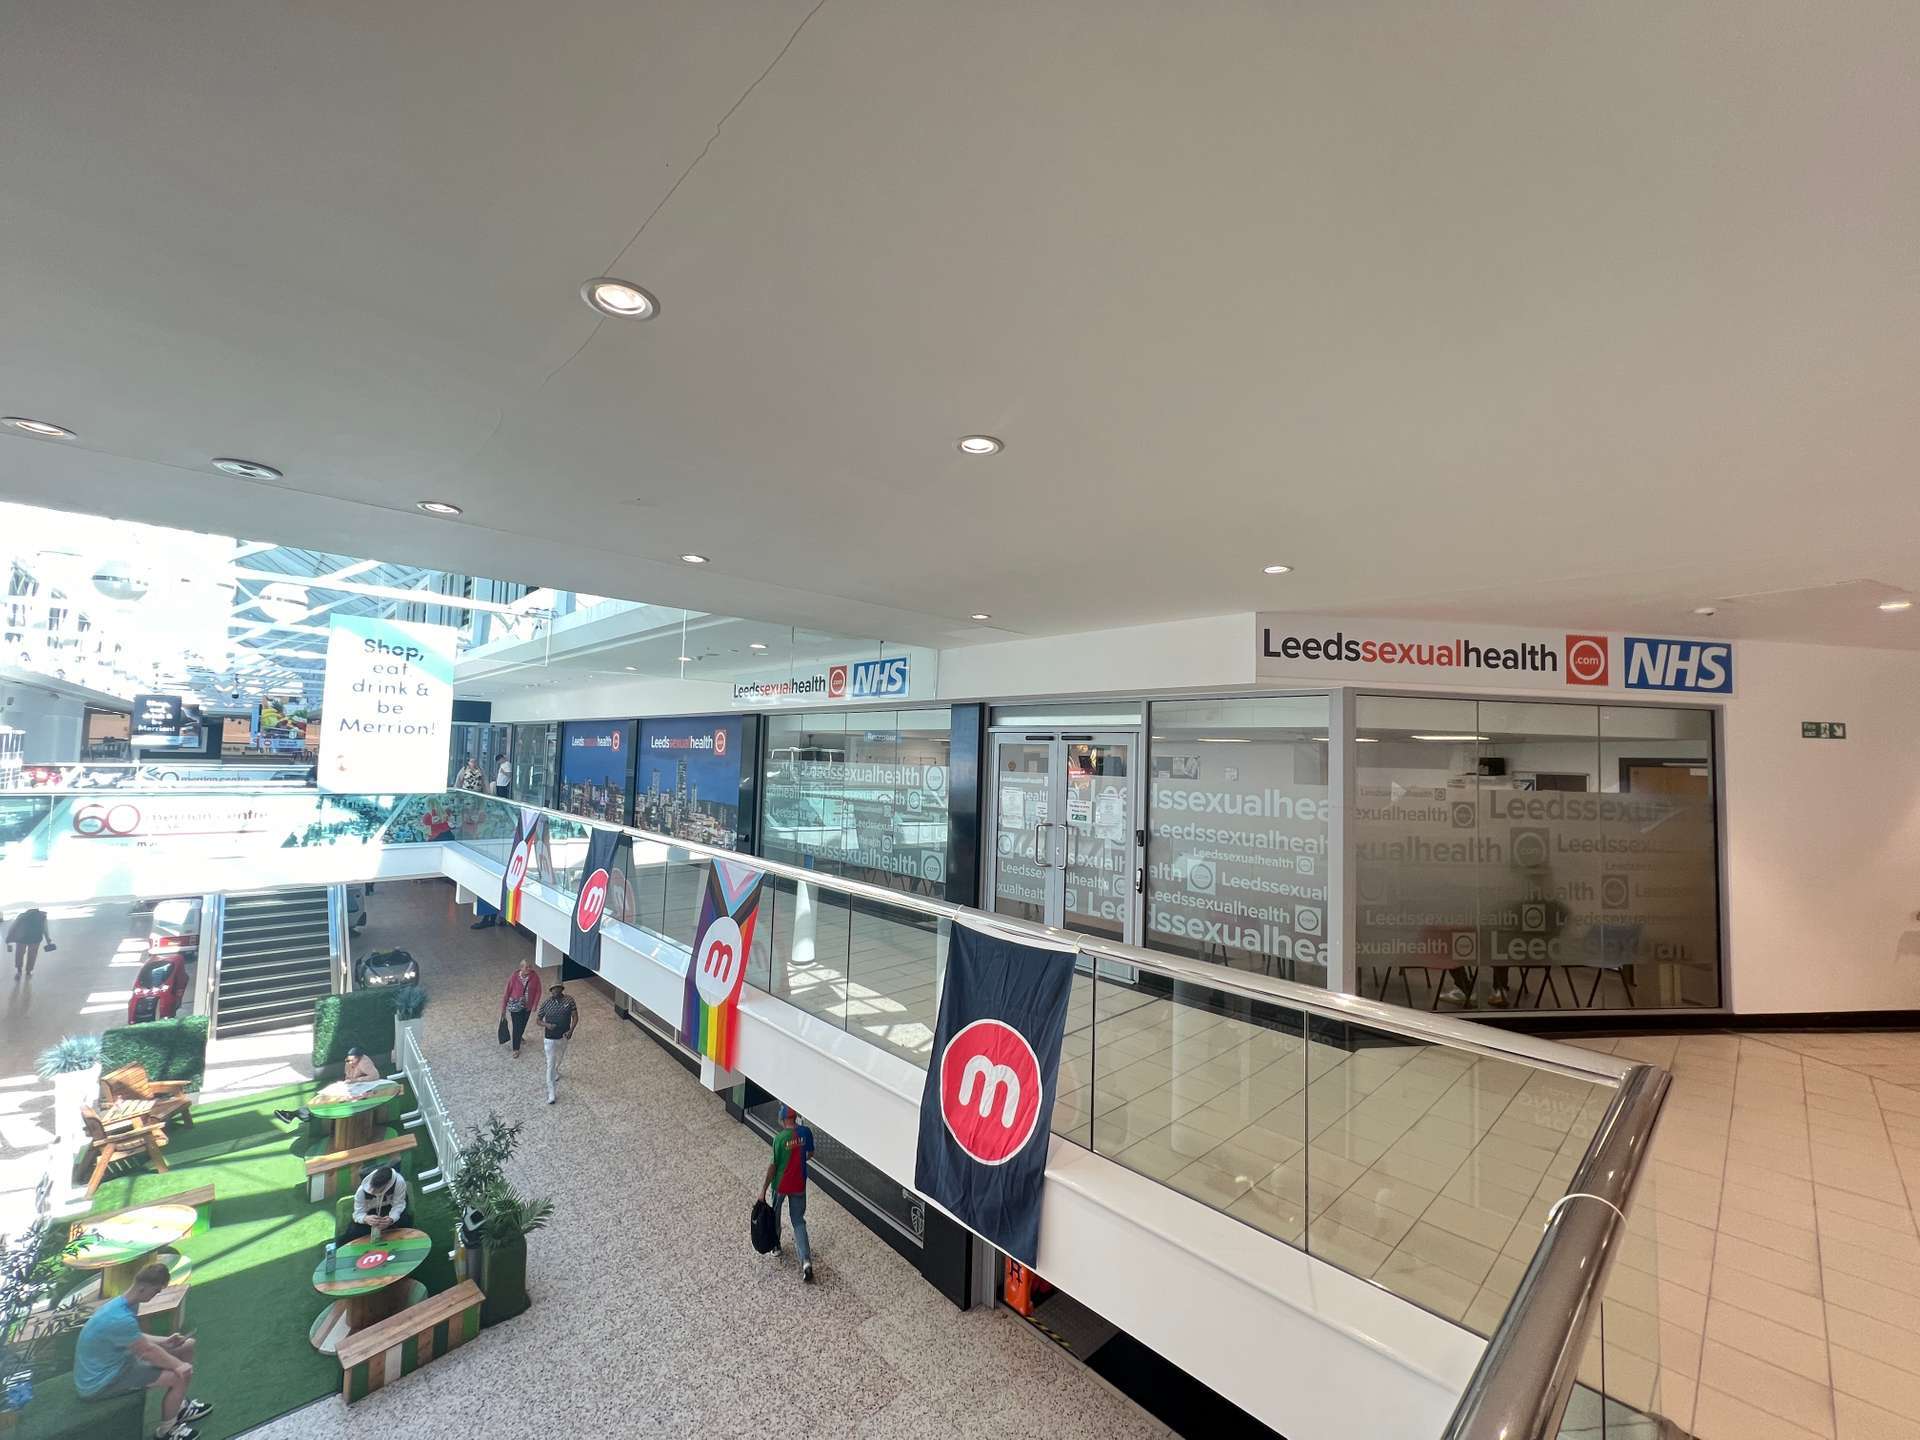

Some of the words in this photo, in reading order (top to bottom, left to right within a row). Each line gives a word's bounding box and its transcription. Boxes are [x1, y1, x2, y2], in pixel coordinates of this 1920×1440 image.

[364, 638, 424, 661] Shop,
[1263, 628, 1557, 672] Leedssexualhealth
[1575, 656, 1598, 666] .com
[1627, 641, 1728, 689] NHS
[352, 679, 408, 696] drink
[416, 682, 429, 697] &
[734, 675, 826, 699] Leedssexualhealth
[854, 660, 906, 694] NHS
[377, 699, 404, 714] be
[339, 718, 436, 735] Merrion!
[651, 735, 713, 750] Leedssexualhealth
[512, 854, 524, 875] m
[1193, 847, 1294, 870] Leedssexualhealth
[584, 885, 605, 914] m
[703, 939, 734, 984] m
[958, 1054, 1021, 1129] m
